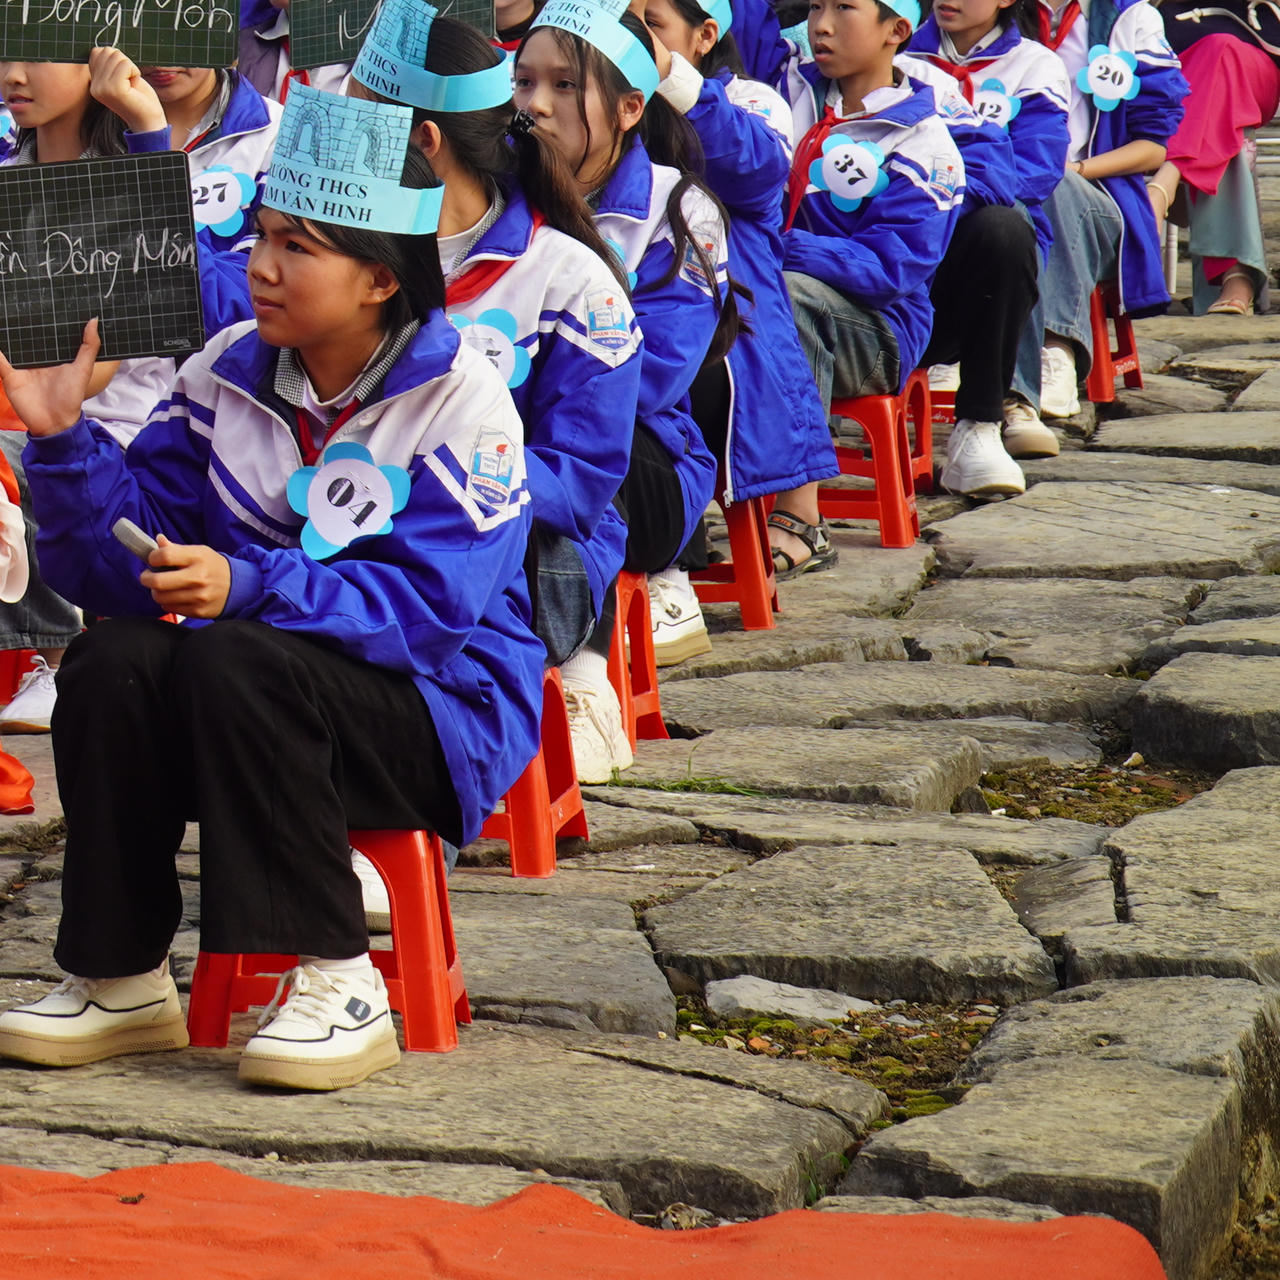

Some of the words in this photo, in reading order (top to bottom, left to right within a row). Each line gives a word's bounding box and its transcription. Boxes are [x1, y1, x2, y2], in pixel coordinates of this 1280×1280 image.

[368, 49, 398, 77] THCS
[1096, 63, 1125, 87] 20
[366, 71, 401, 97] HINH
[833, 153, 868, 186] 37
[193, 182, 230, 206] 27
[317, 176, 369, 200] THCS
[282, 190, 318, 213] VĂN
[322, 200, 373, 223] HINH
[39, 230, 123, 299] Đông
[133, 227, 198, 275] Môn
[326, 476, 378, 530] 04
